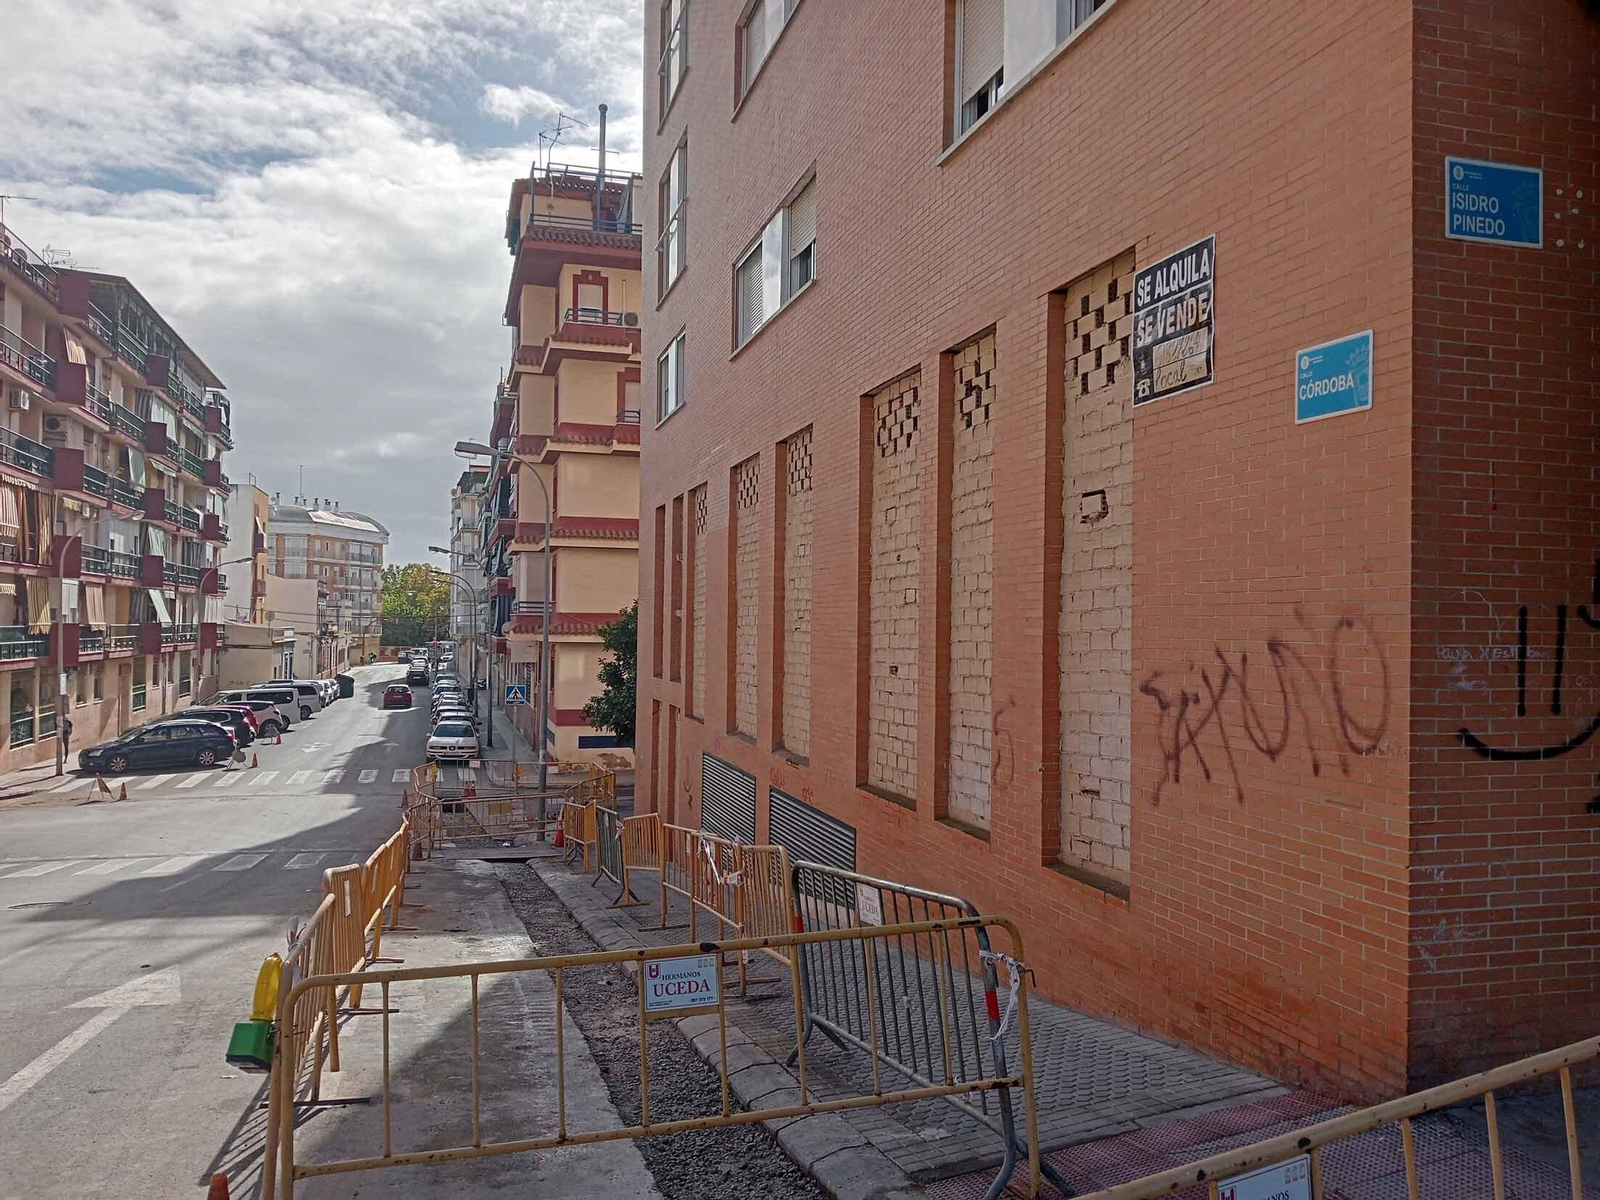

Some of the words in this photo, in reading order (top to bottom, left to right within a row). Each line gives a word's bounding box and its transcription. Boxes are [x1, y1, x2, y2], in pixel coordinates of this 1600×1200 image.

[1452, 192, 1499, 214] ISIDRO
[1453, 214, 1506, 236] PINEDO
[1137, 275, 1152, 307] SE
[1154, 248, 1210, 299] ALQUILA
[1137, 315, 1154, 349] SE
[1157, 291, 1209, 339] VENDE
[1300, 372, 1354, 400] CÓRDOBA
[662, 971, 701, 981] HERMANOS
[653, 979, 711, 997] UCEDA
